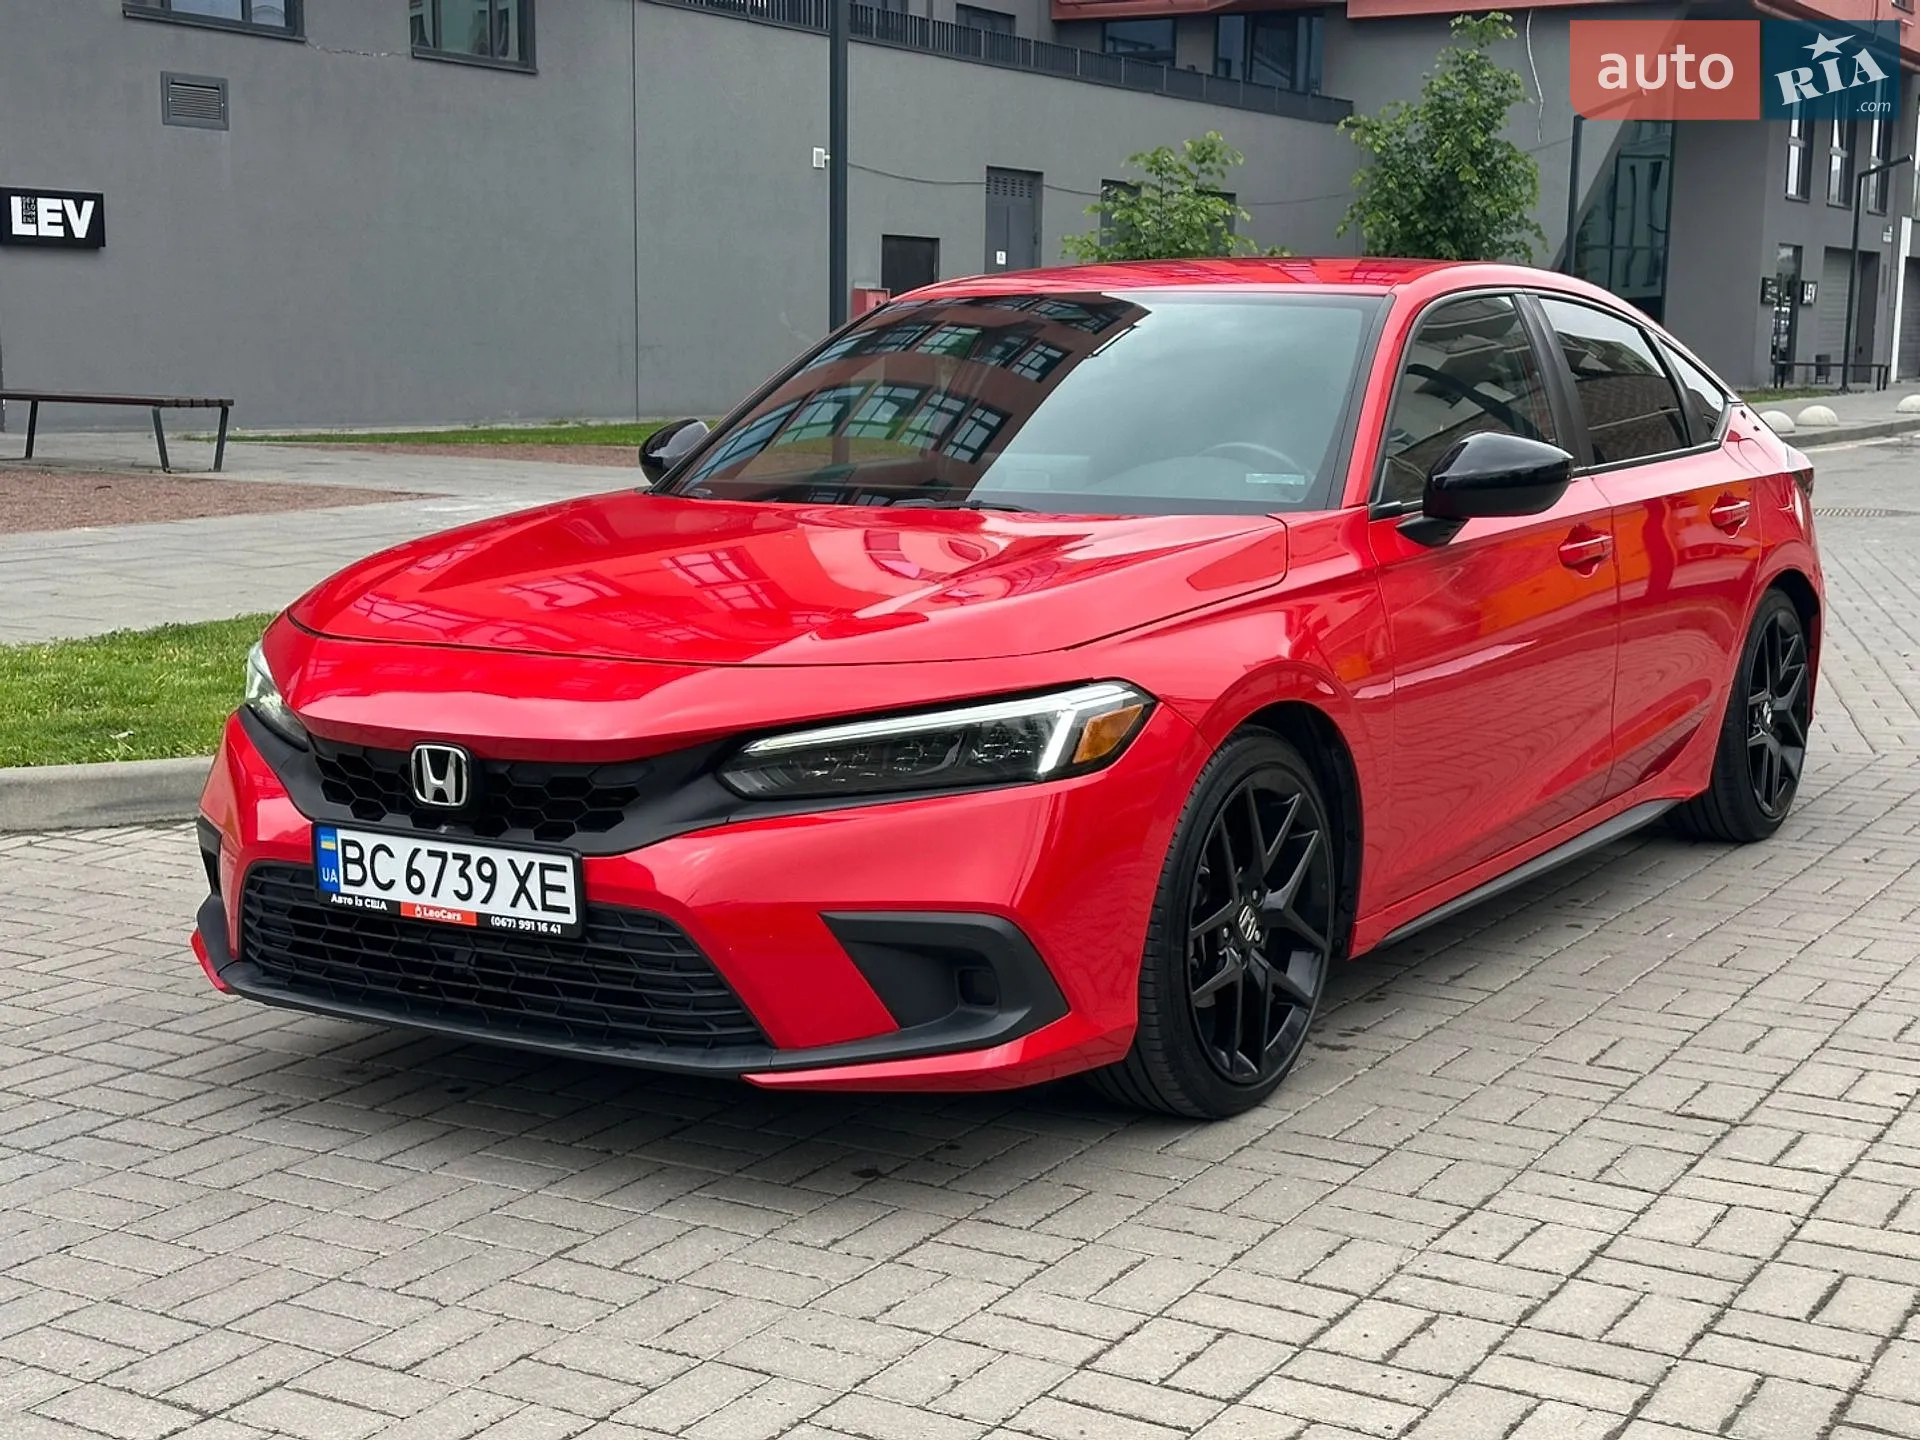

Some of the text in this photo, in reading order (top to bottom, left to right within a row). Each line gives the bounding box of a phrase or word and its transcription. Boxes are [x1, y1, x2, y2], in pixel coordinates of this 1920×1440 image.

[10, 195, 95, 239] LEV
[322, 867, 338, 883] UA
[340, 838, 571, 914] BC 6739 XE
[330, 893, 353, 906] Авто
[423, 906, 463, 921] LeoCars
[490, 916, 562, 934] (067) 991 16 41
